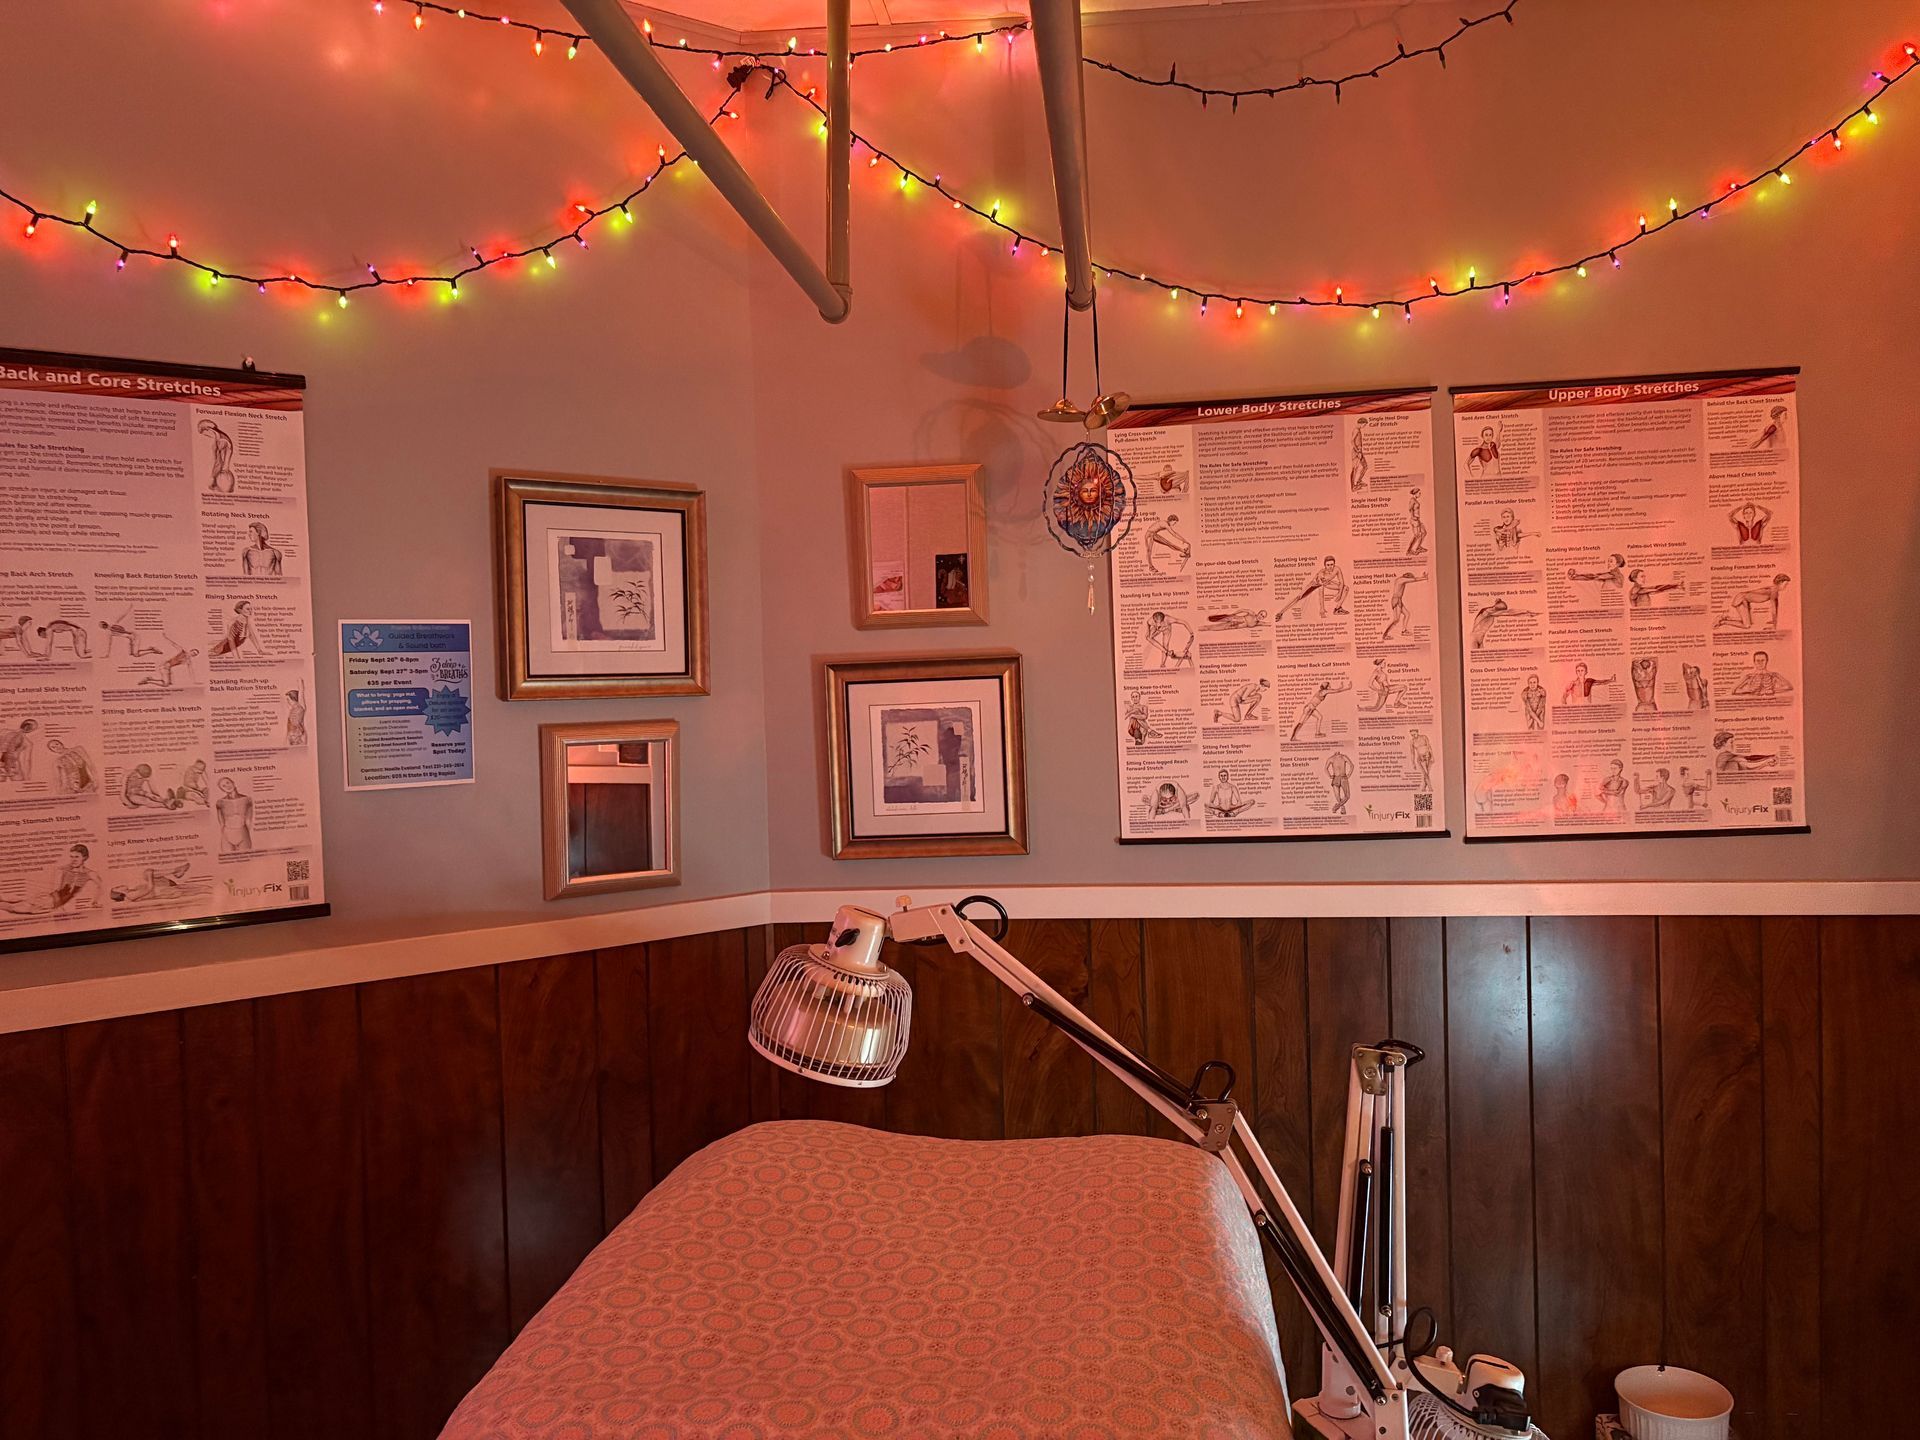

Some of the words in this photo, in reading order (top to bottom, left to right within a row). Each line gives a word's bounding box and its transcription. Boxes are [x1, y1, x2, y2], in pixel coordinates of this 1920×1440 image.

[0, 366, 41, 381] Back
[45, 370, 80, 385] and
[87, 373, 130, 389] Core
[136, 377, 222, 396] Stretches
[1549, 388, 1592, 403] Upper
[1594, 386, 1628, 400] Body
[1634, 382, 1698, 395] Stretches
[1198, 406, 1238, 416] Lower
[1242, 404, 1275, 414] Body
[1279, 399, 1341, 411] Stretches
[430, 657, 441, 673] 3
[440, 669, 468, 679] BREATHS
